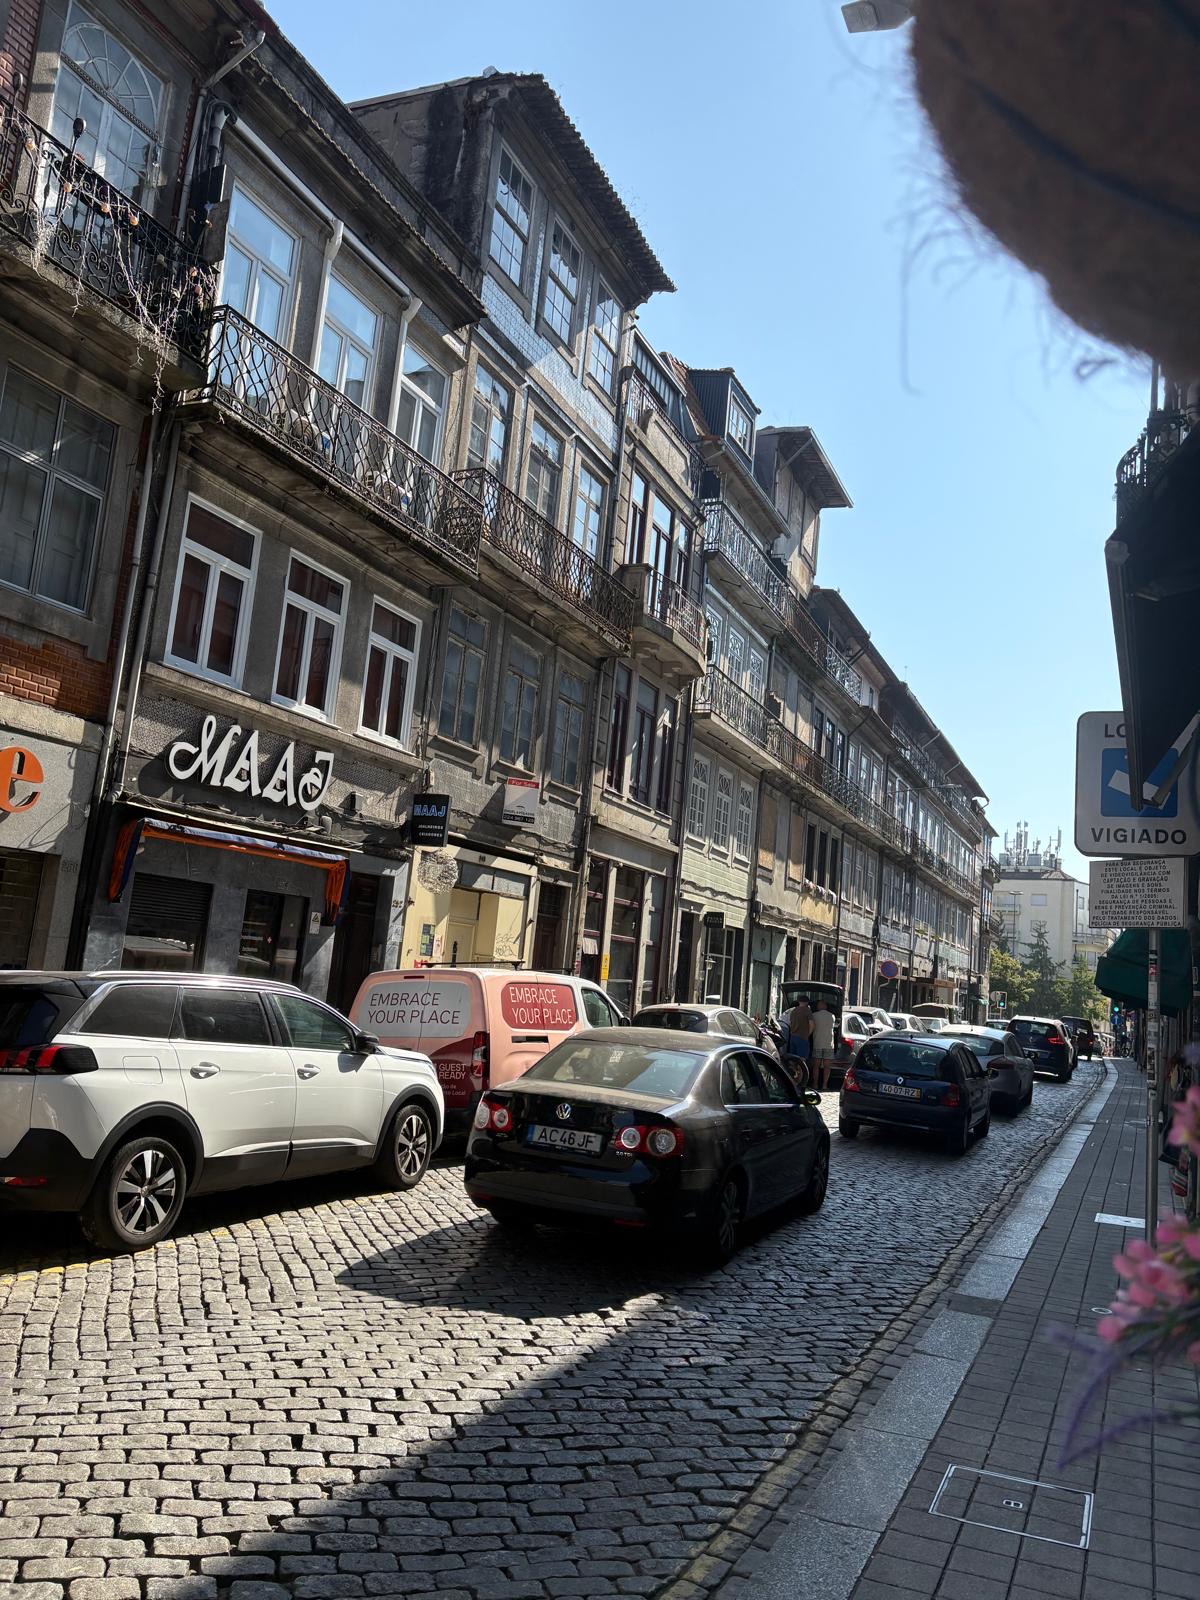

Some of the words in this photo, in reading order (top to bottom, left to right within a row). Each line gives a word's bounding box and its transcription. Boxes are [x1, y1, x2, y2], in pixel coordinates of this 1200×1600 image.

[413, 804, 446, 817] MAAJ
[1091, 827, 1187, 845] VIGIADO
[369, 992, 441, 1007] EMBRACE
[509, 986, 559, 1004] EMBRACE
[367, 1010, 405, 1024] YOUR
[409, 1010, 461, 1025] PLACE
[512, 1007, 541, 1024] YOUR
[543, 1008, 573, 1025] PLACE
[439, 1063, 467, 1071] GUEST
[439, 1071, 467, 1080] READY
